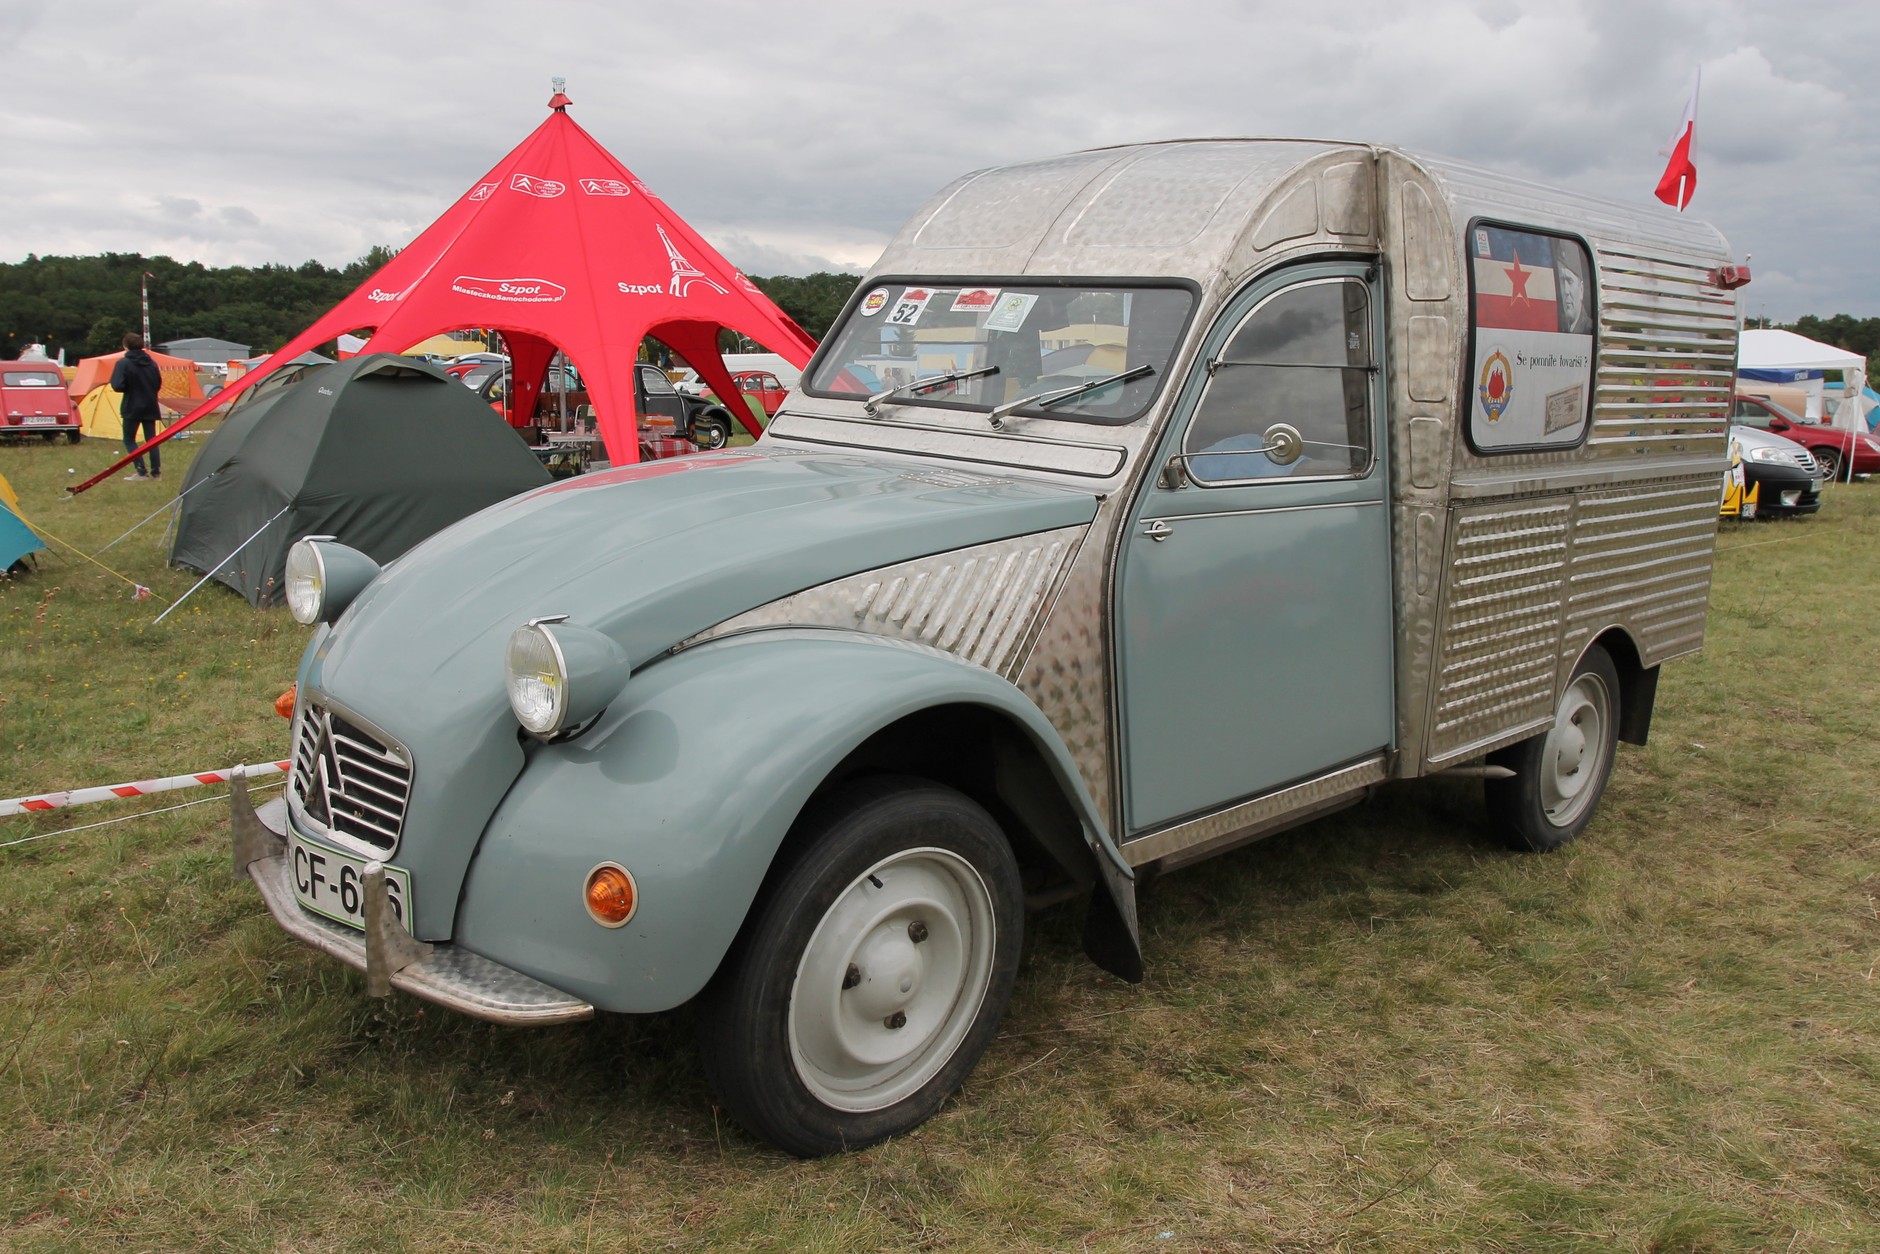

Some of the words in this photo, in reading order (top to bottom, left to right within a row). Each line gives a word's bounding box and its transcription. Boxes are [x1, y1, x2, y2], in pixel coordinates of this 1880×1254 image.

[367, 288, 401, 304] Szpot
[452, 284, 562, 303] MiasteczkoSamochodowe.pl
[499, 282, 541, 295] Szpot
[617, 282, 664, 296] Szpot
[892, 303, 919, 323] 52
